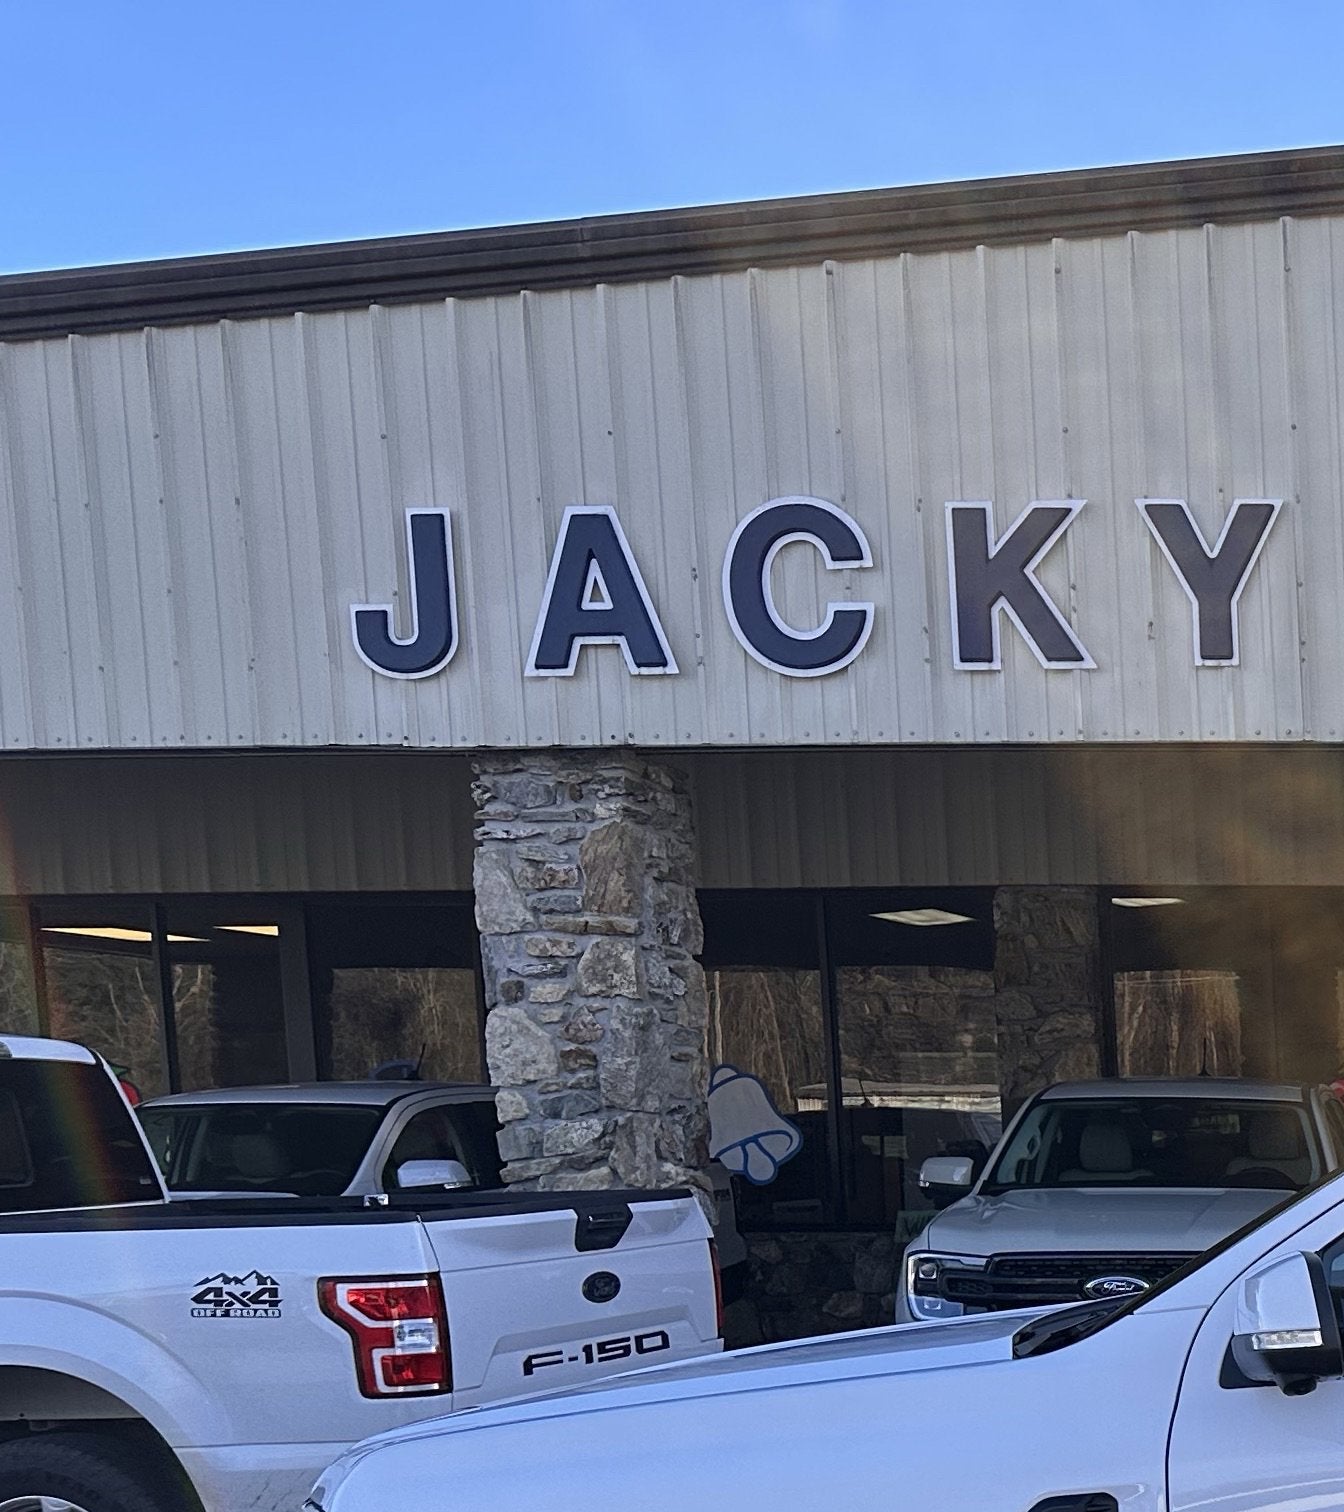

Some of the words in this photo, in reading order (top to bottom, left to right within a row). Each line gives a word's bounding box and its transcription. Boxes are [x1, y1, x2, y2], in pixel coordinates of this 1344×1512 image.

[351, 496, 1283, 679] JACKY
[192, 1309, 226, 1318] OFF
[229, 1309, 280, 1318] ROAD
[523, 1330, 671, 1377] F-150
